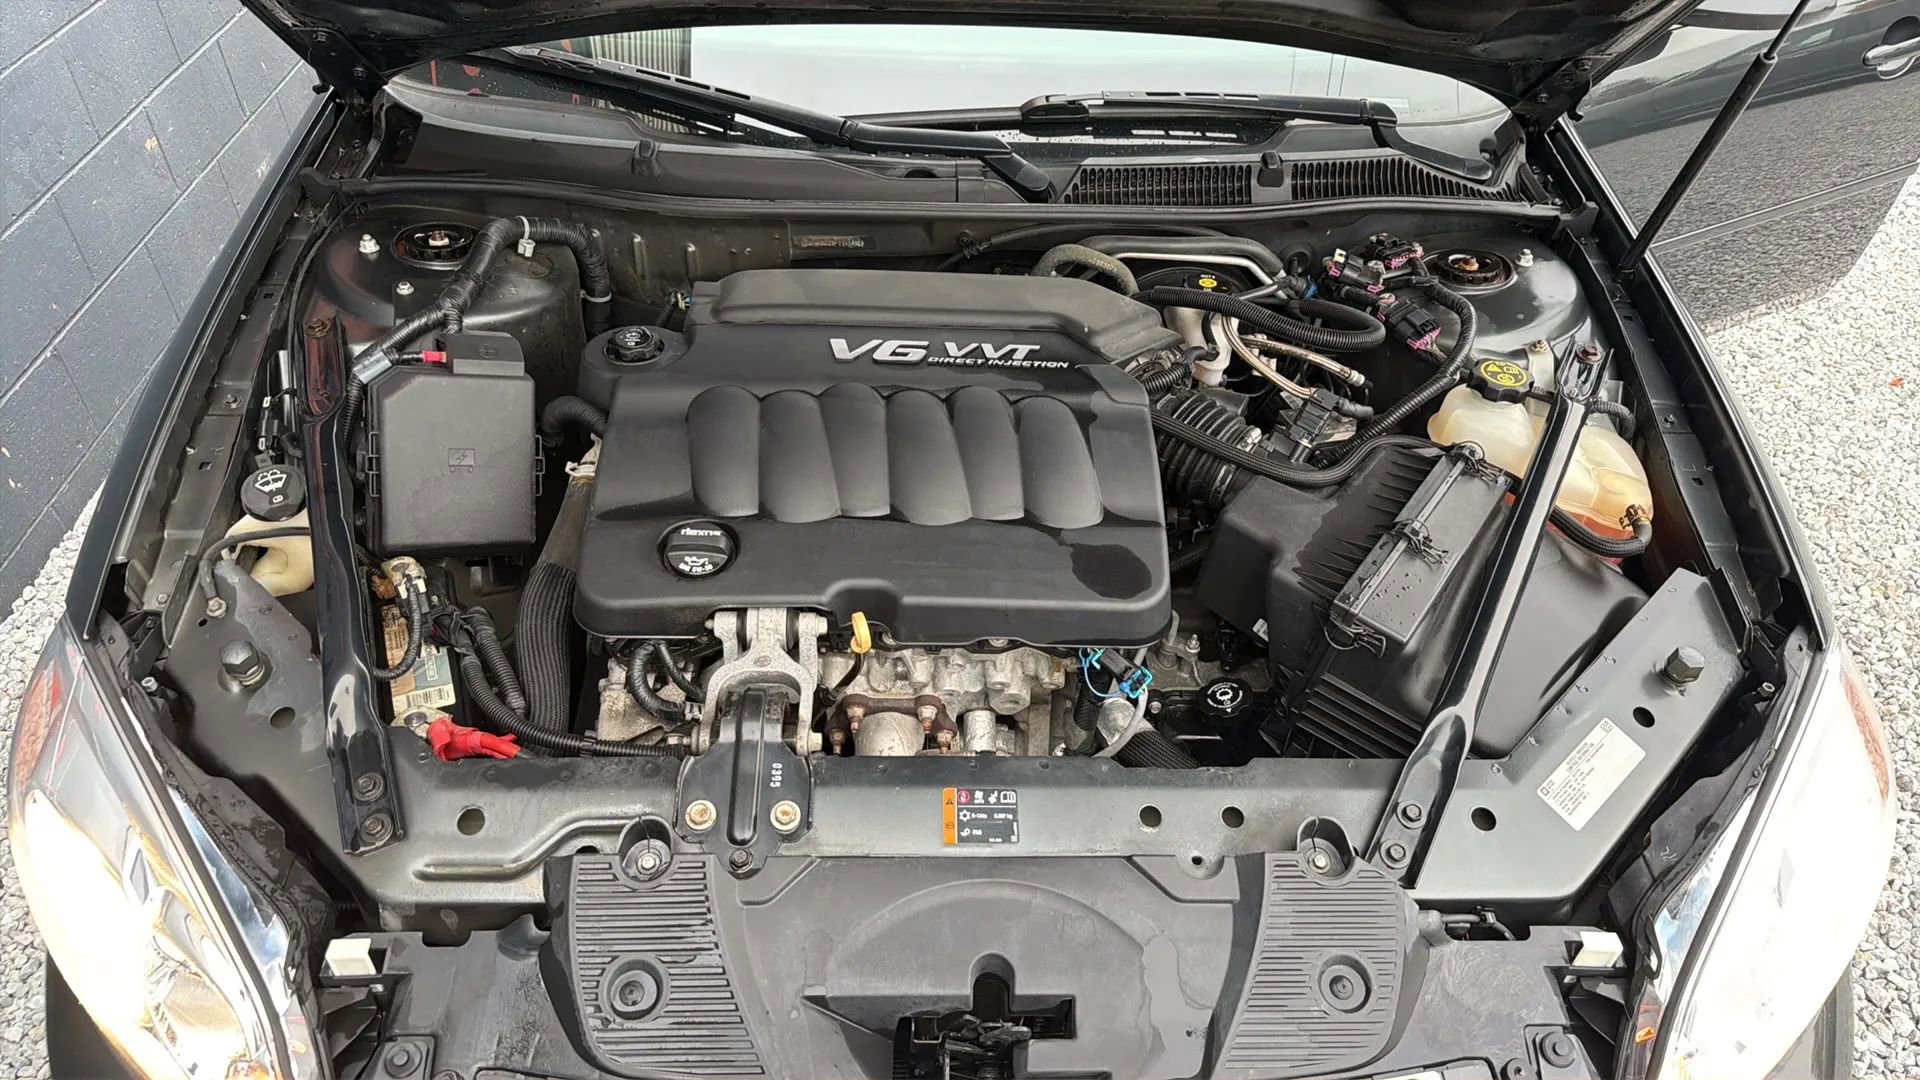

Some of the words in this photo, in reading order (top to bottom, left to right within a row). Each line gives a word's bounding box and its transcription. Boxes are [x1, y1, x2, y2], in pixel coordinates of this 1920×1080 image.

[829, 338, 930, 362] V6
[944, 341, 1041, 359] VVT
[927, 356, 985, 365] DIRECT
[986, 358, 1070, 369] INJECTION
